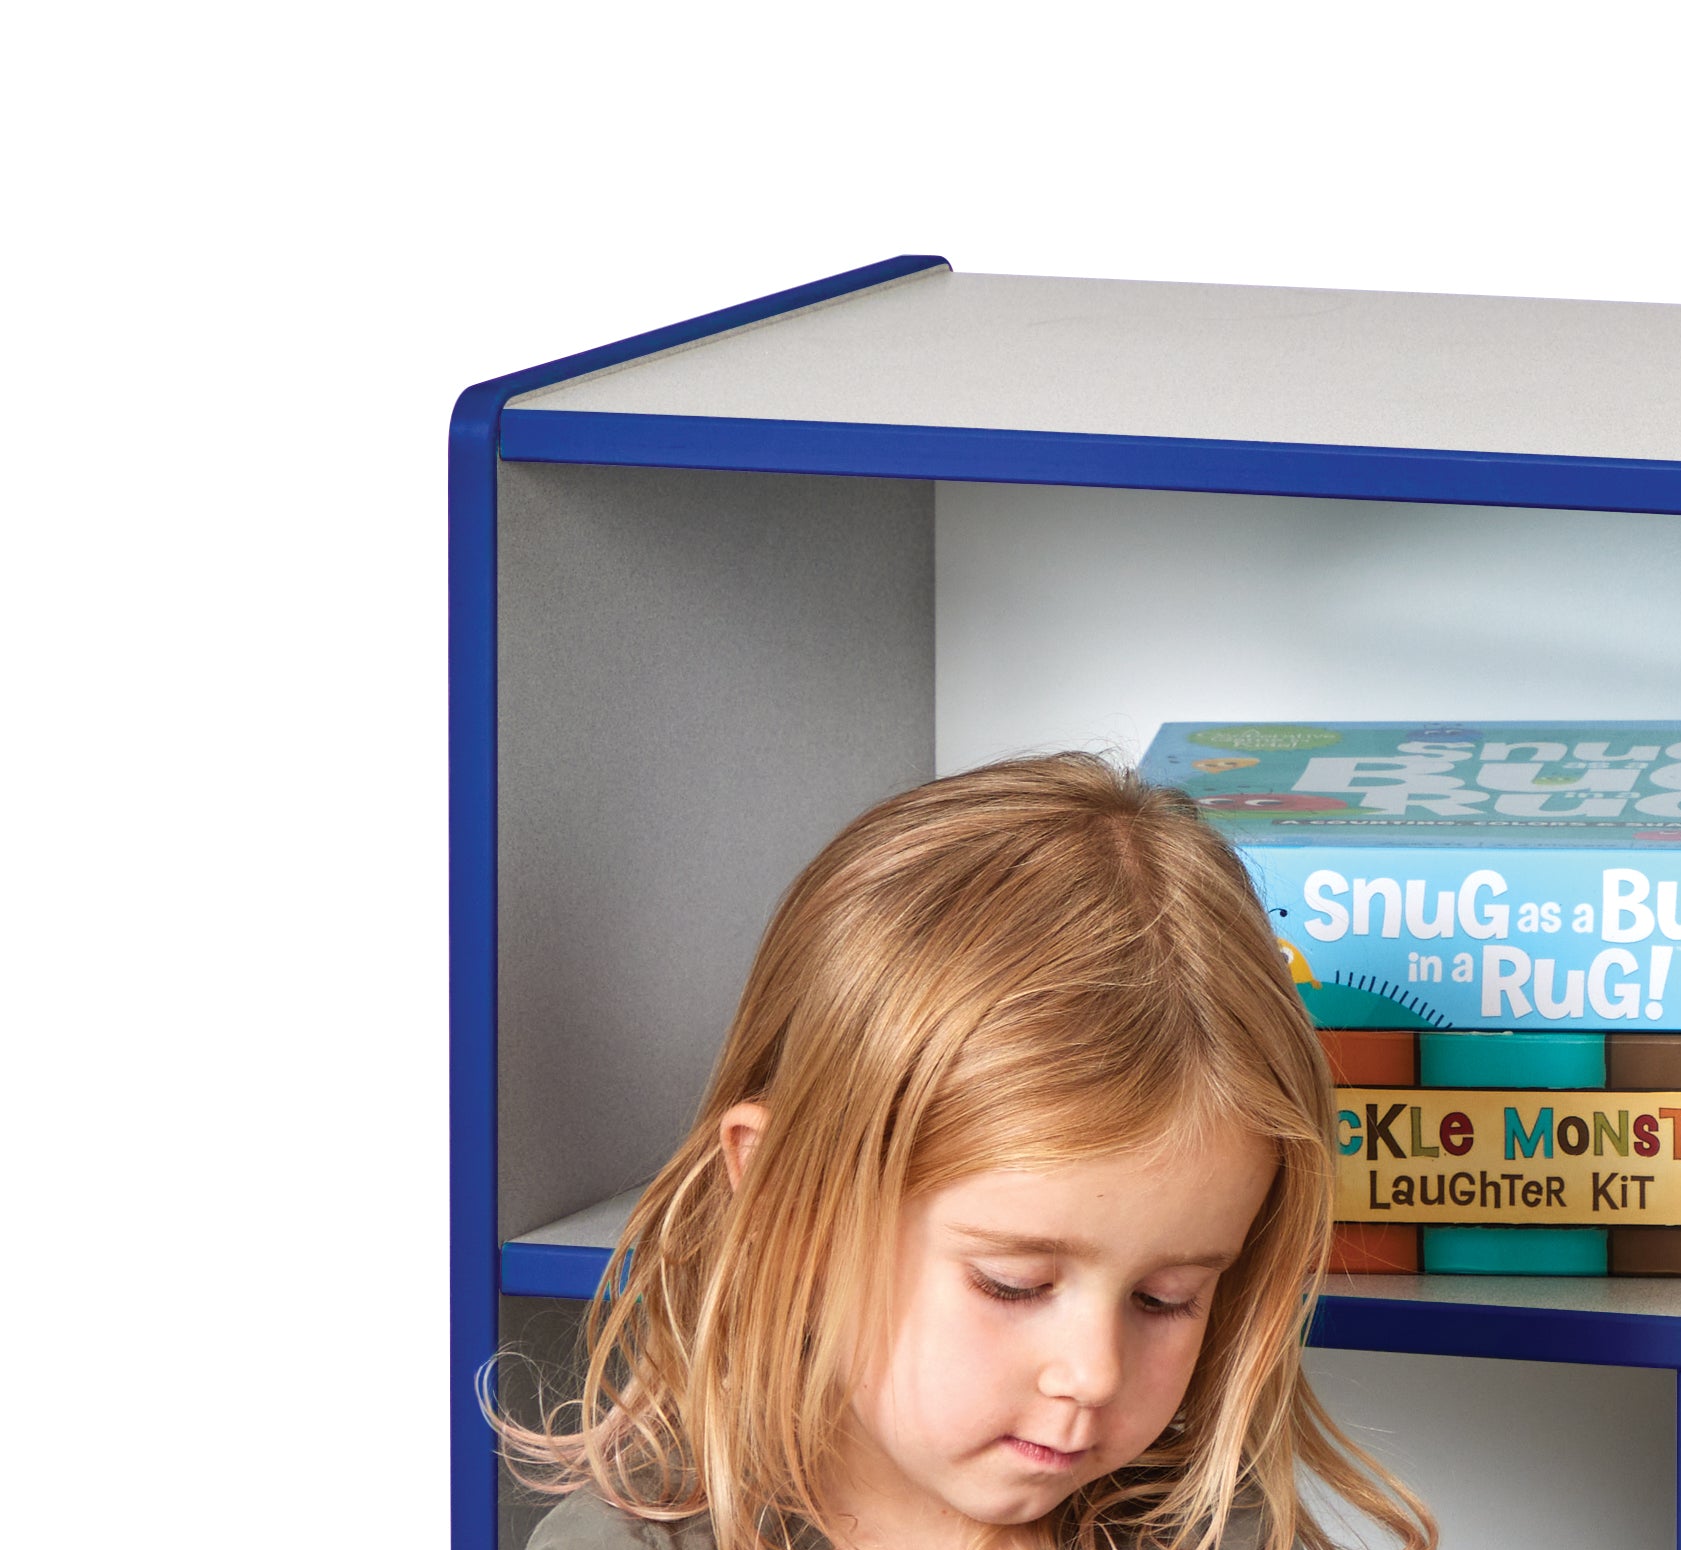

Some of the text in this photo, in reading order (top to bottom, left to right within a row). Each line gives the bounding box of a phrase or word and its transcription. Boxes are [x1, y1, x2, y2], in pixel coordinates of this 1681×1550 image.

[1517, 901, 1562, 934] as
[1571, 902, 1595, 934] a
[1408, 951, 1443, 983] in
[1451, 952, 1474, 983] a
